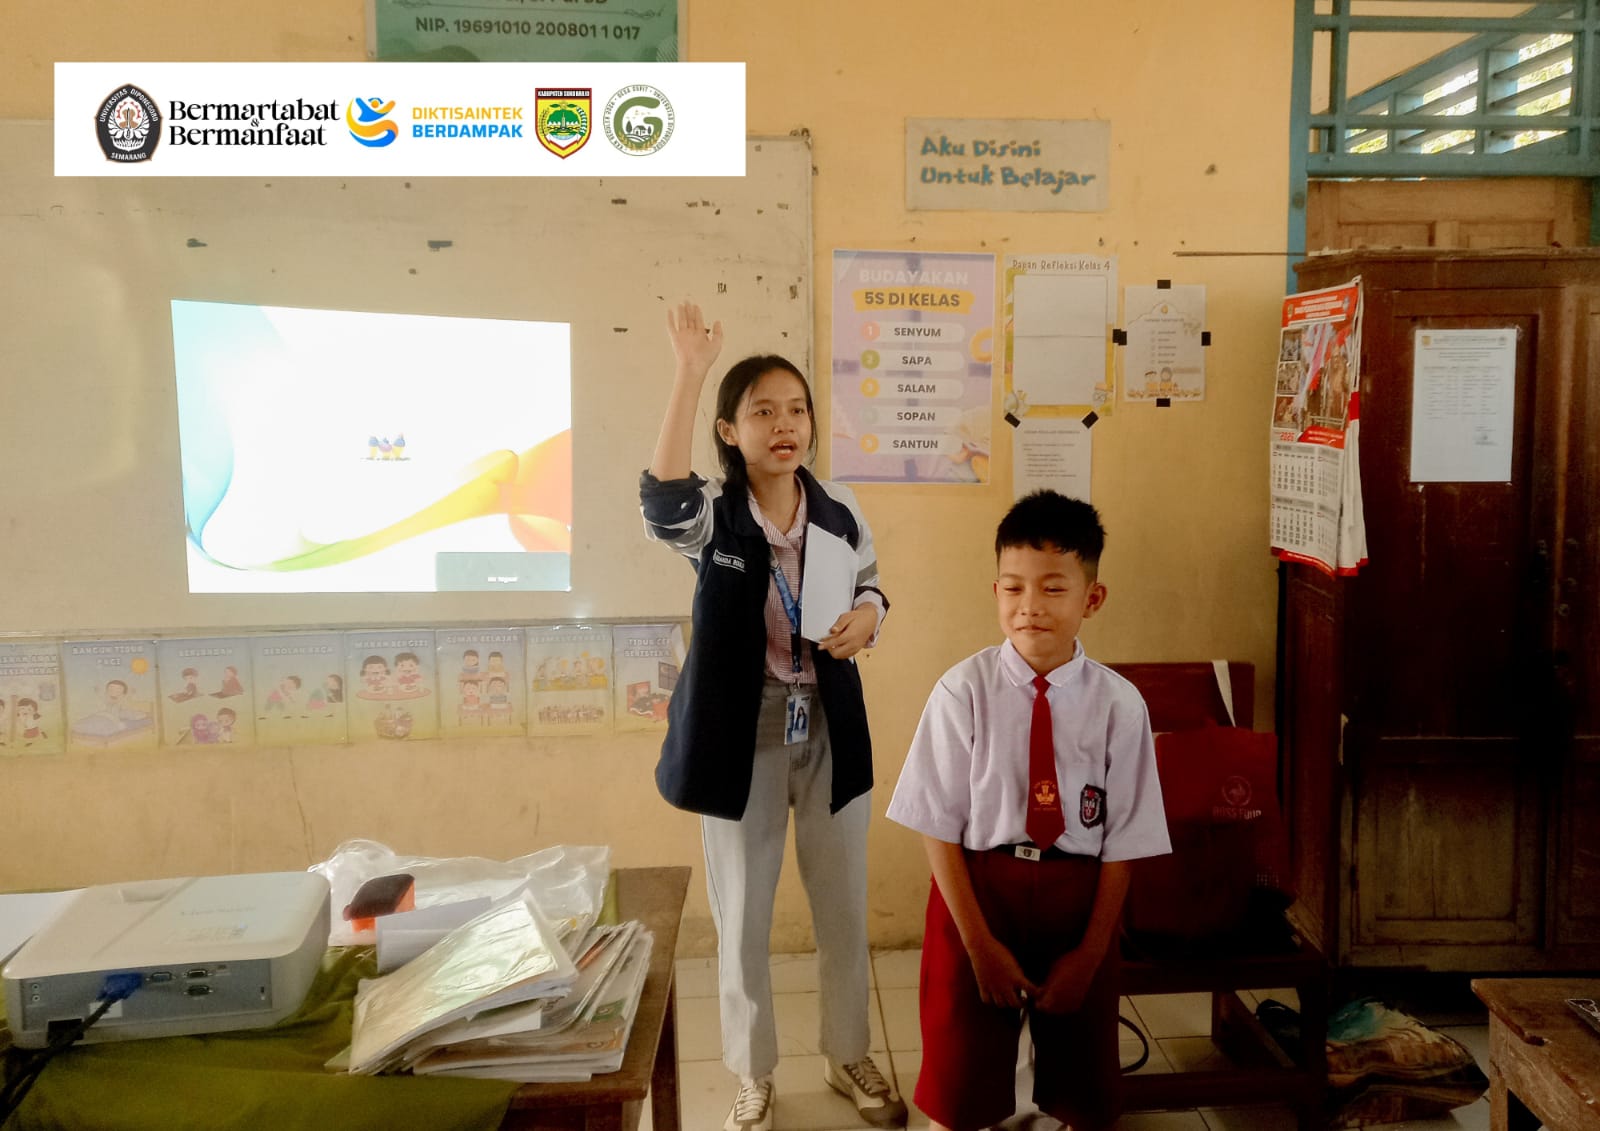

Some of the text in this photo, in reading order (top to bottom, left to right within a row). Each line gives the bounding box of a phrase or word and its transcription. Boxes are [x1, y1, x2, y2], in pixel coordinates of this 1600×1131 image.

[415, 17, 449, 33] NIP.
[453, 19, 531, 35] 19691010
[613, 25, 641, 40] 017
[920, 135, 1041, 157] Aku Disini
[920, 164, 1097, 195] Untuk Belajar
[1103, 260, 1111, 271] 4
[859, 269, 969, 285] BUDAYAKAN
[864, 292, 960, 307] 5S DI KELAS
[894, 327, 942, 338] SENYUM
[902, 356, 932, 366] SAPA
[897, 384, 936, 394] SALAM
[896, 412, 936, 421] SOPAN
[892, 439, 939, 450] SANTUN
